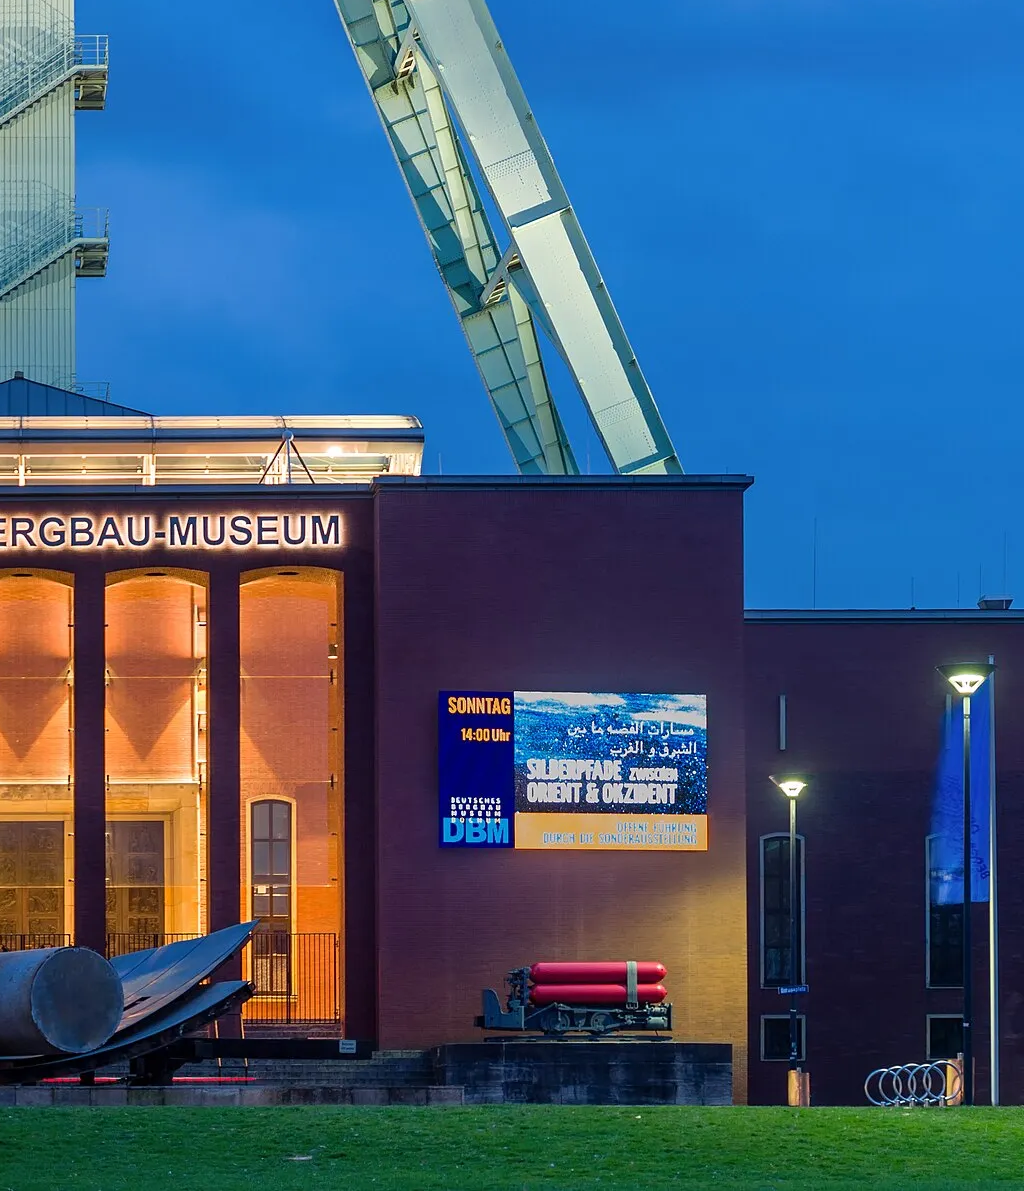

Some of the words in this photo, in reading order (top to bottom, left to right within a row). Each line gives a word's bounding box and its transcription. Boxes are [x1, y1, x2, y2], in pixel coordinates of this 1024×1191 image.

[448, 696, 511, 715] SONNTAG
[461, 727, 490, 741] 14:00
[491, 728, 511, 742] Uhr
[648, 721, 695, 739] مسارات
[527, 759, 622, 781] SILBERPFADE
[450, 796, 501, 804] DEUTSCHES
[527, 782, 582, 803] ORIENT
[585, 783, 599, 803] &
[602, 783, 677, 804] OKZIDENT
[443, 817, 509, 843] DBM
[617, 821, 648, 833] OFFENE
[543, 832, 576, 844] DURCH
[580, 832, 594, 844] DIE
[599, 833, 697, 845] SONDERAUSSTELLUNG
